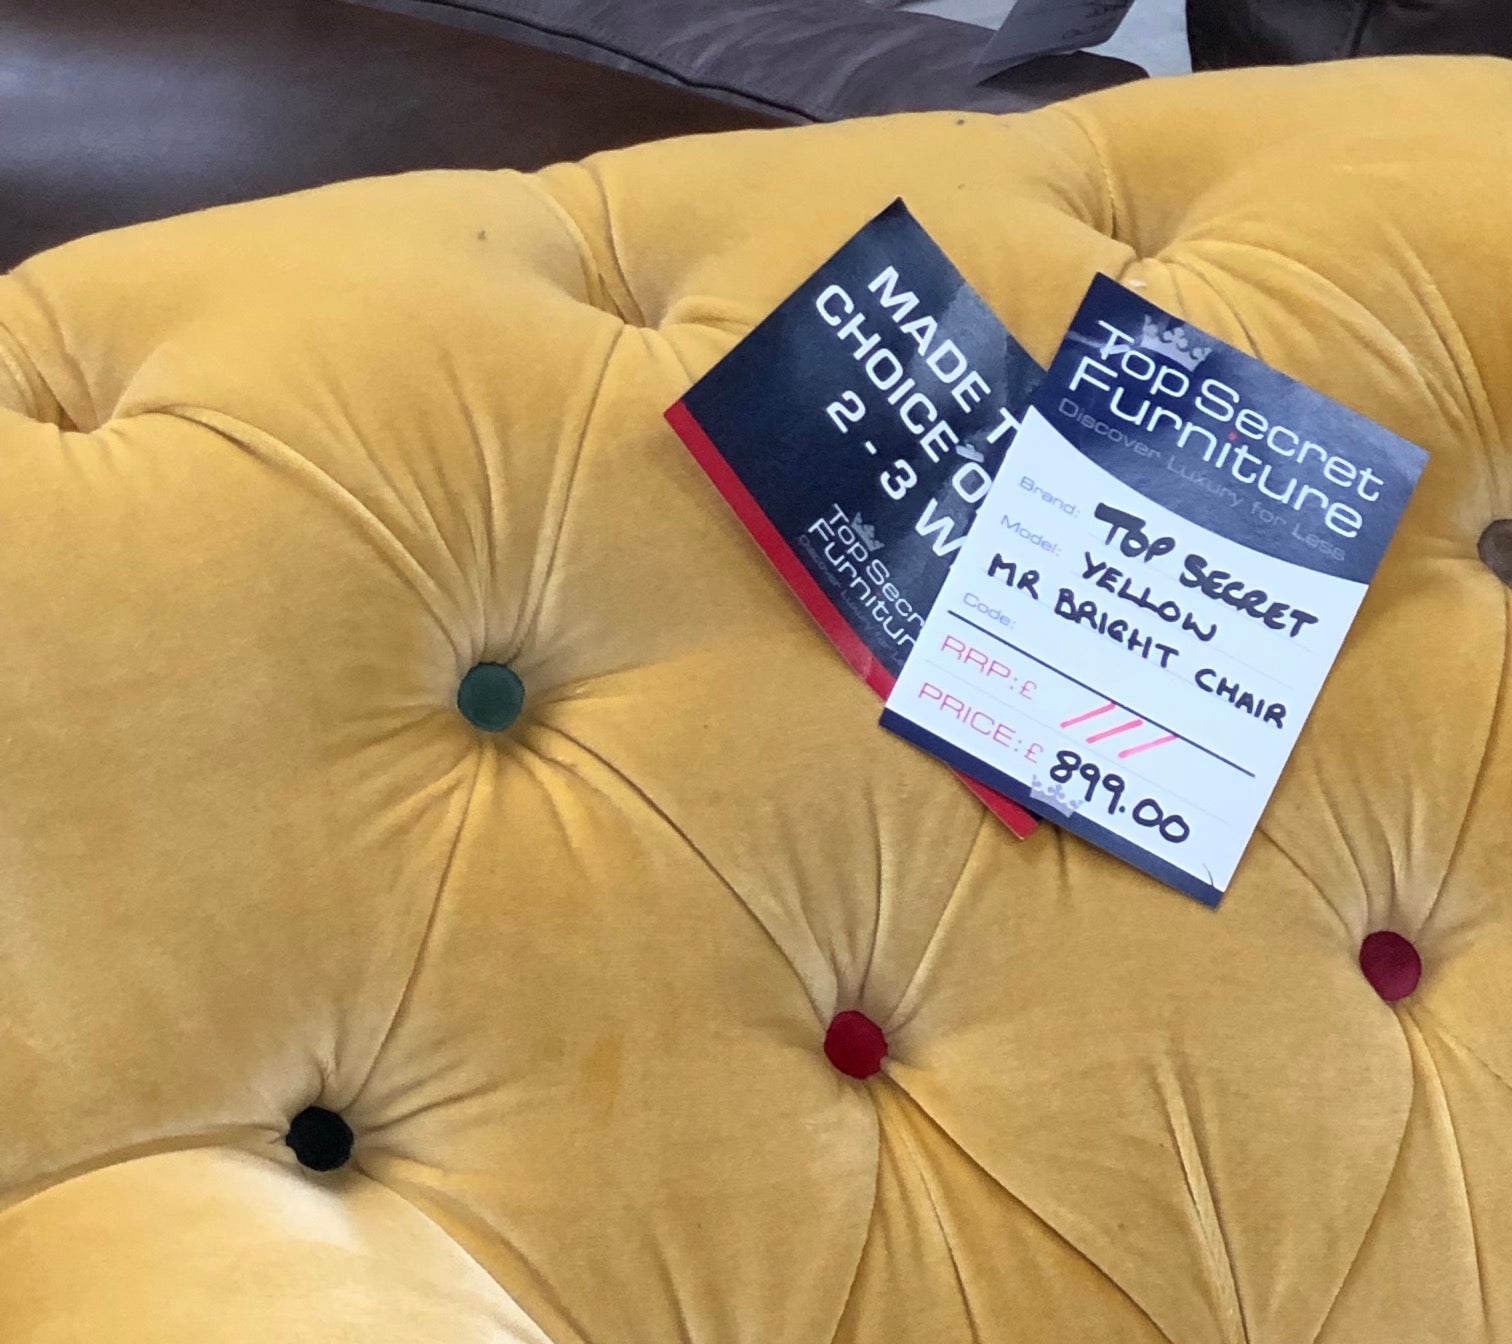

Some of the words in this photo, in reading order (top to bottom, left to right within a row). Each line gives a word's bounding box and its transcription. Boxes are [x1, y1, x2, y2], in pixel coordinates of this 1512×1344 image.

[815, 284, 960, 464] CHOICE
[868, 265, 991, 414] MADE
[1097, 319, 1190, 399] Top
[1195, 378, 1385, 502] Secret
[826, 390, 866, 434] 2
[880, 458, 918, 500] 3
[1057, 397, 1162, 460] Discover
[1166, 455, 1245, 509] Luxury
[1249, 500, 1288, 526] for
[1290, 524, 1346, 562] Less
[1068, 355, 1363, 539] Furniture
[962, 592, 1017, 630] Code:
[999, 513, 1063, 557] Model:
[1082, 551, 1218, 642] YELLOW
[1018, 475, 1080, 520] Brand:
[1094, 502, 1176, 563] TOP
[1178, 553, 1319, 638] SECRET
[987, 553, 1039, 600] MR
[1054, 588, 1180, 669] BRIGHT
[1195, 668, 1287, 729] CHAIR
[1050, 750, 1190, 843] 899.00
